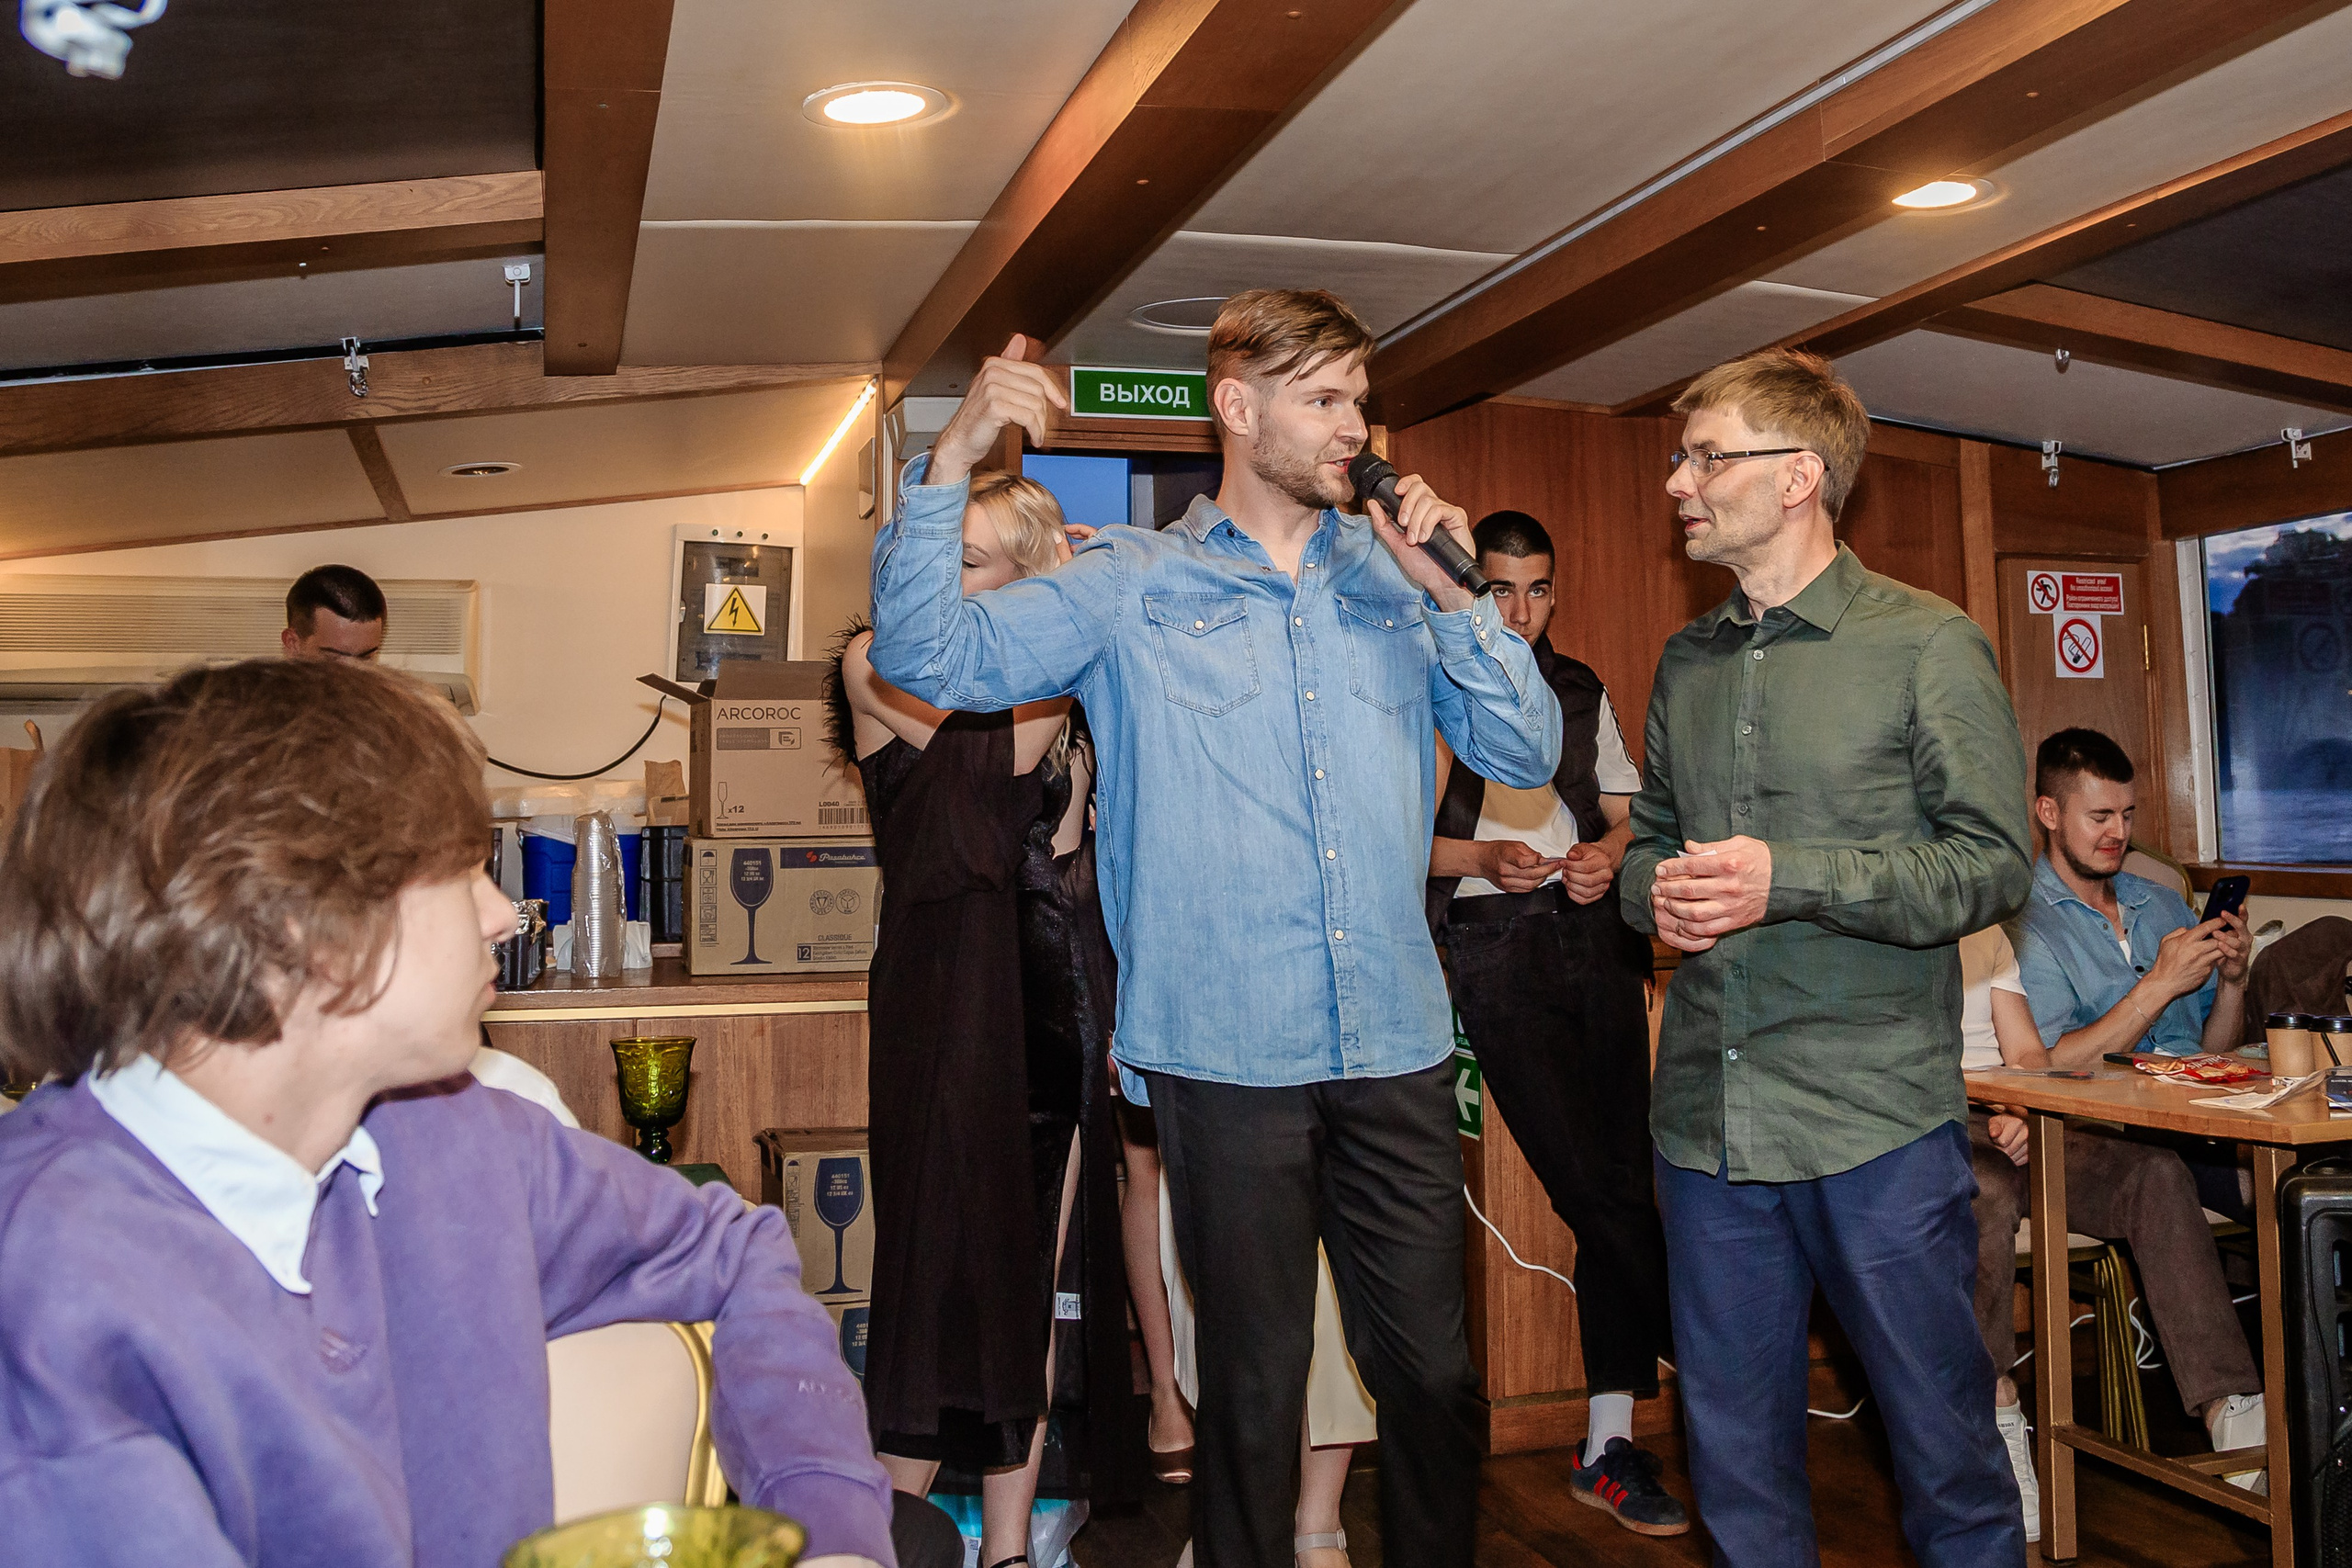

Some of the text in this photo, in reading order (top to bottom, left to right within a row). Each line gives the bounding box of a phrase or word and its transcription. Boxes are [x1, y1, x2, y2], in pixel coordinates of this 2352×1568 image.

[1100, 382, 1191, 409] ВЫХОД
[717, 707, 801, 720] ARCOROC
[728, 805, 744, 814] x12
[797, 947, 809, 959] 12
